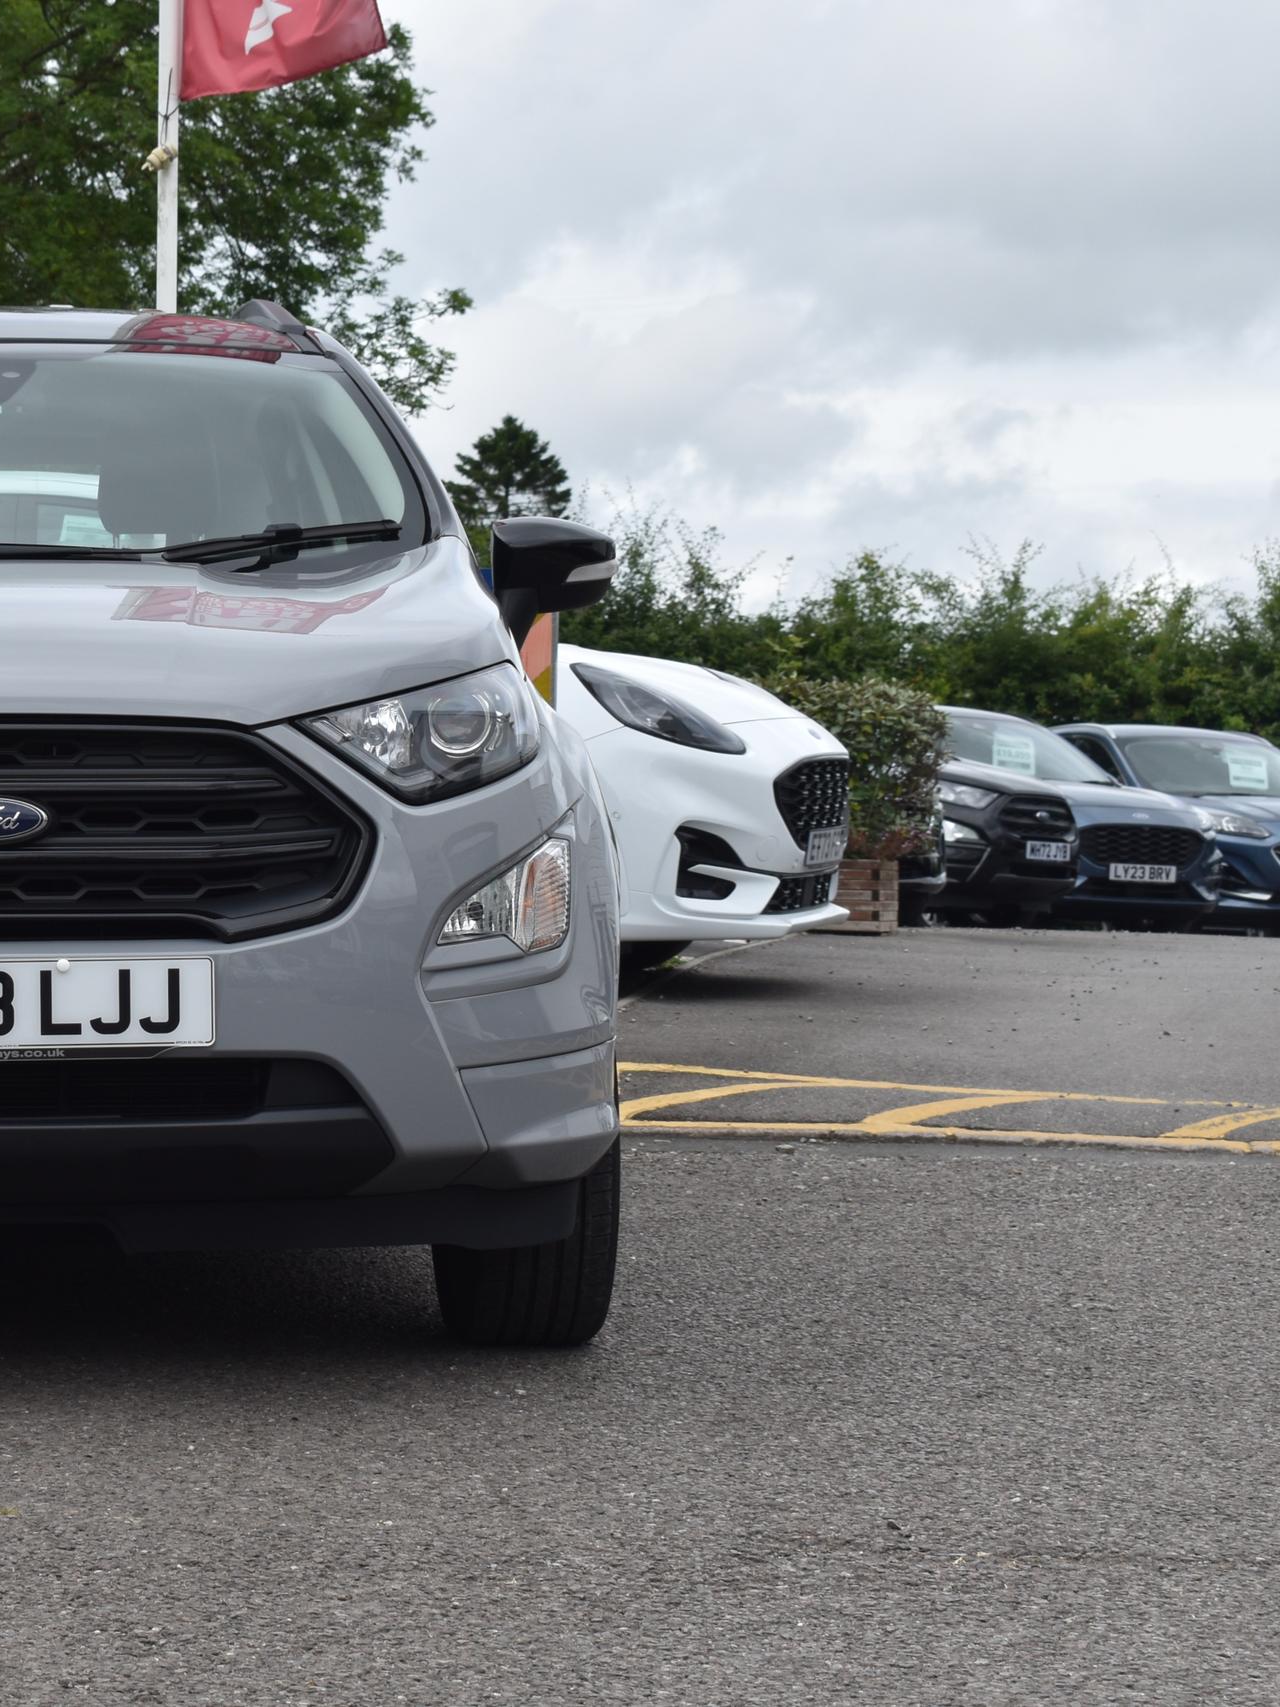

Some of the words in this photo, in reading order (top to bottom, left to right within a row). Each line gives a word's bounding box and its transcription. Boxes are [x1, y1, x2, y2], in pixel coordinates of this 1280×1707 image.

[1114, 866, 1145, 879] LY23
[1148, 867, 1172, 881] BRV
[40, 968, 180, 1036] LJJ
